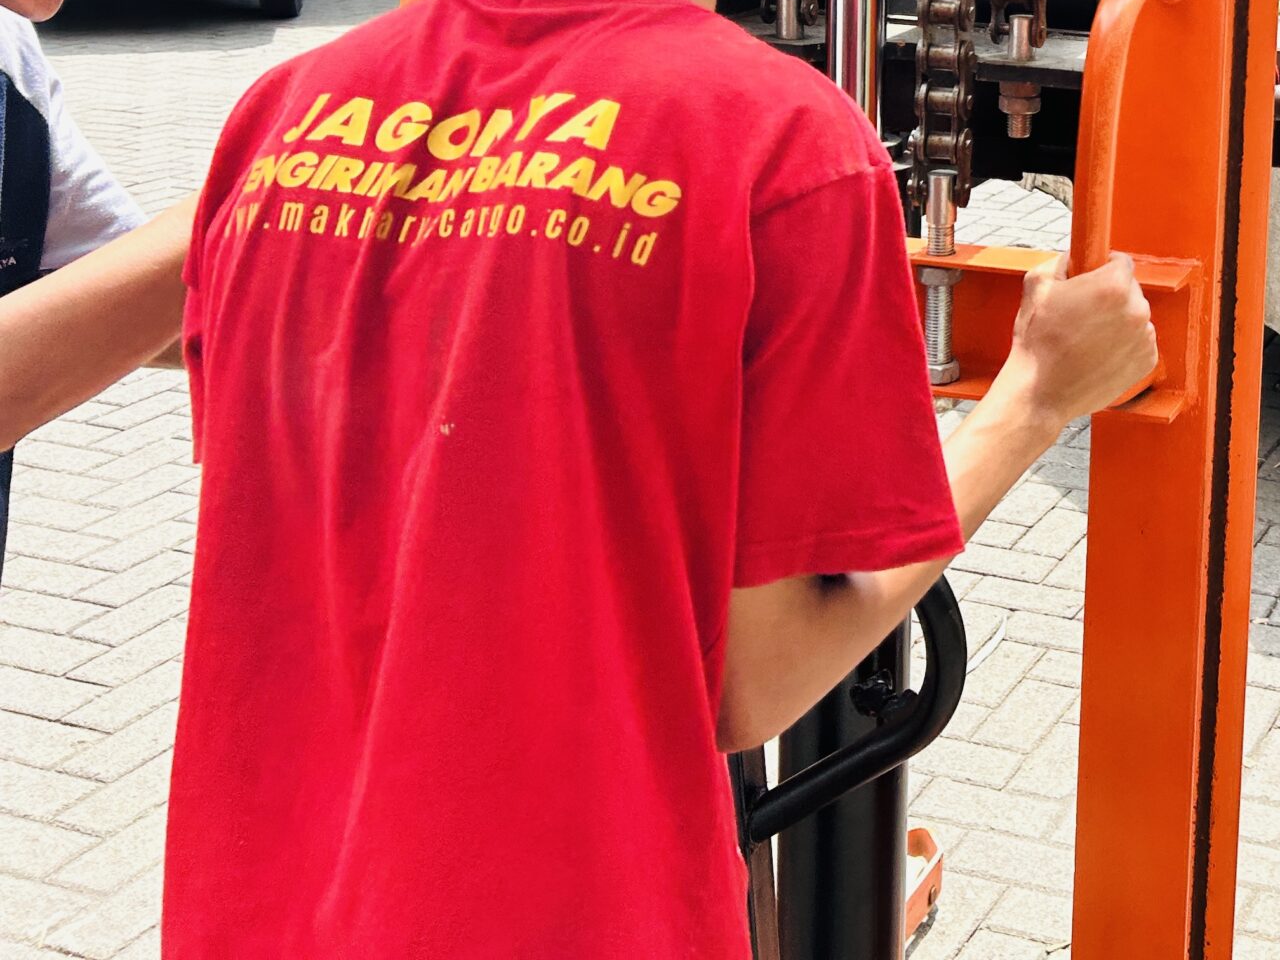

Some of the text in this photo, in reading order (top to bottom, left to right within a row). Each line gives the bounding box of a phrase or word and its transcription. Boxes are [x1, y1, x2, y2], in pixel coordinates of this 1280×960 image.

[282, 93, 621, 161] JAGONYA
[242, 151, 682, 217] ENGIRIMAN BARANG
[224, 201, 658, 266] w.makharycargo.co.id
